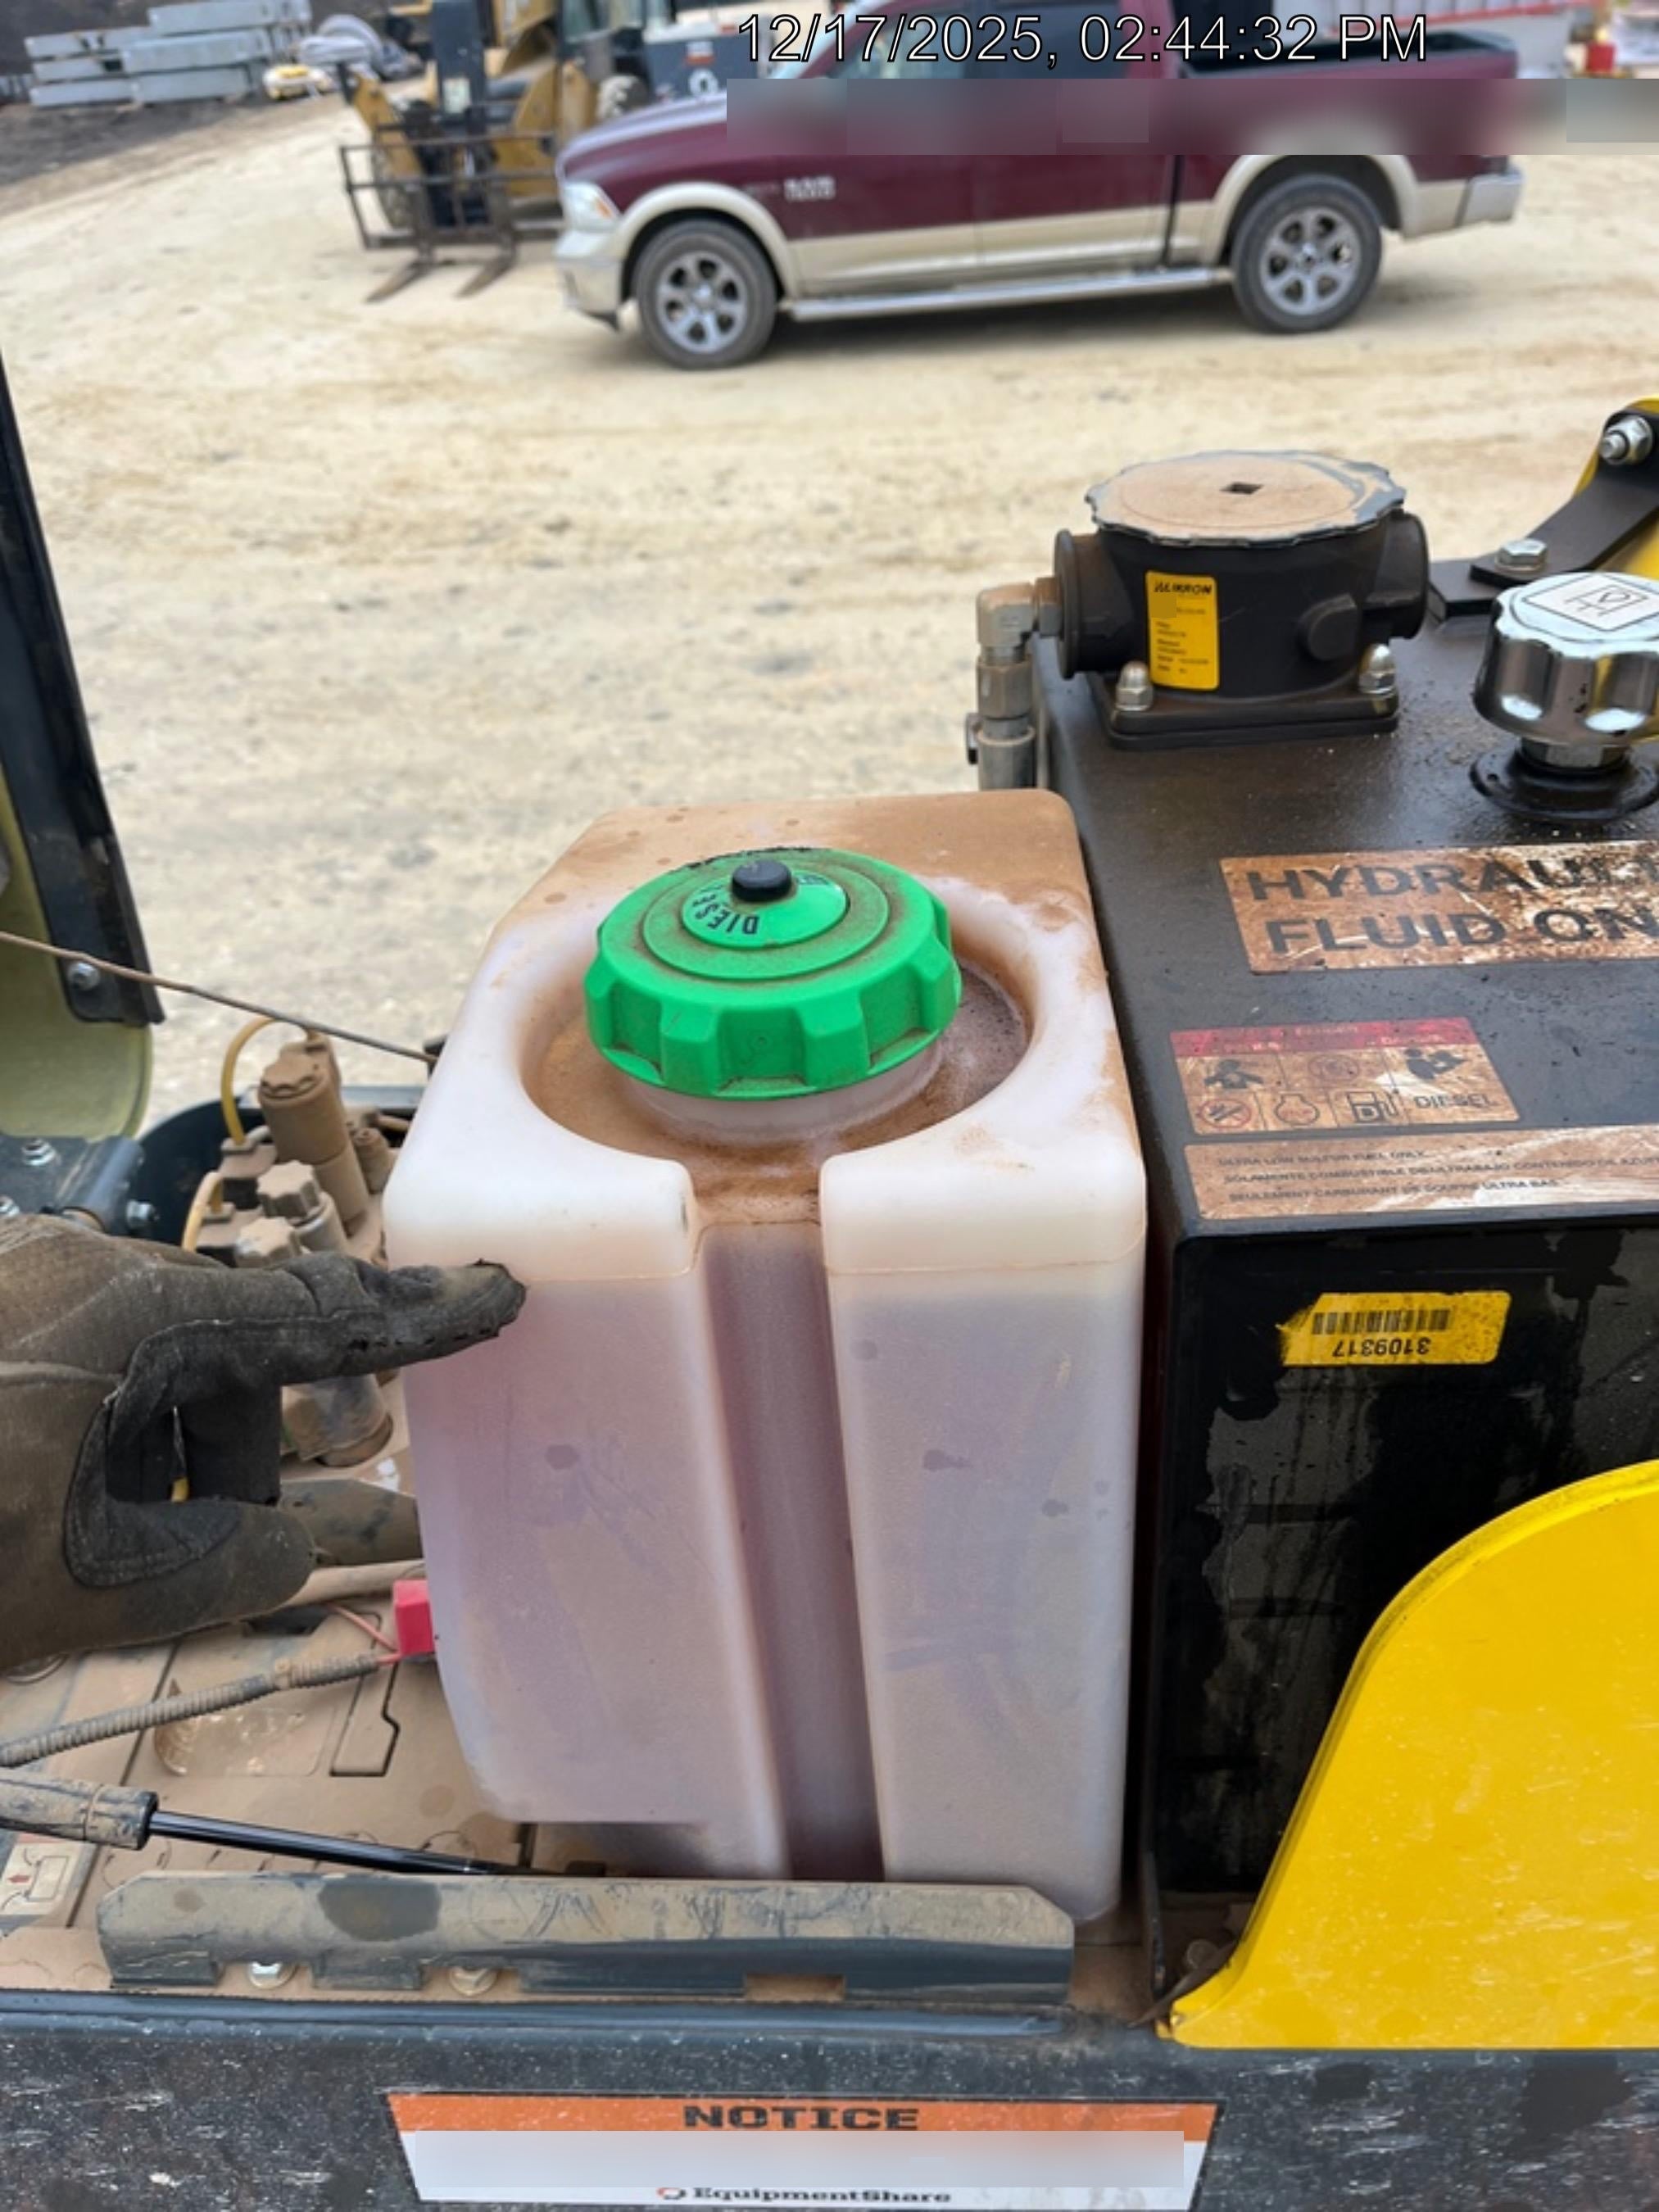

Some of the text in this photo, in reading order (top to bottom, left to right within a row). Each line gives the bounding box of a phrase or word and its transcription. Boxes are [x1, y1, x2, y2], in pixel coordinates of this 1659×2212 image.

[1265, 911, 1507, 955] FLUID
[1414, 1094, 1498, 1109] DIESEL
[1331, 1337, 1432, 1358] 3109317
[683, 2105, 919, 2130] NOTICE
[694, 2187, 952, 2202] EquipmentShare
